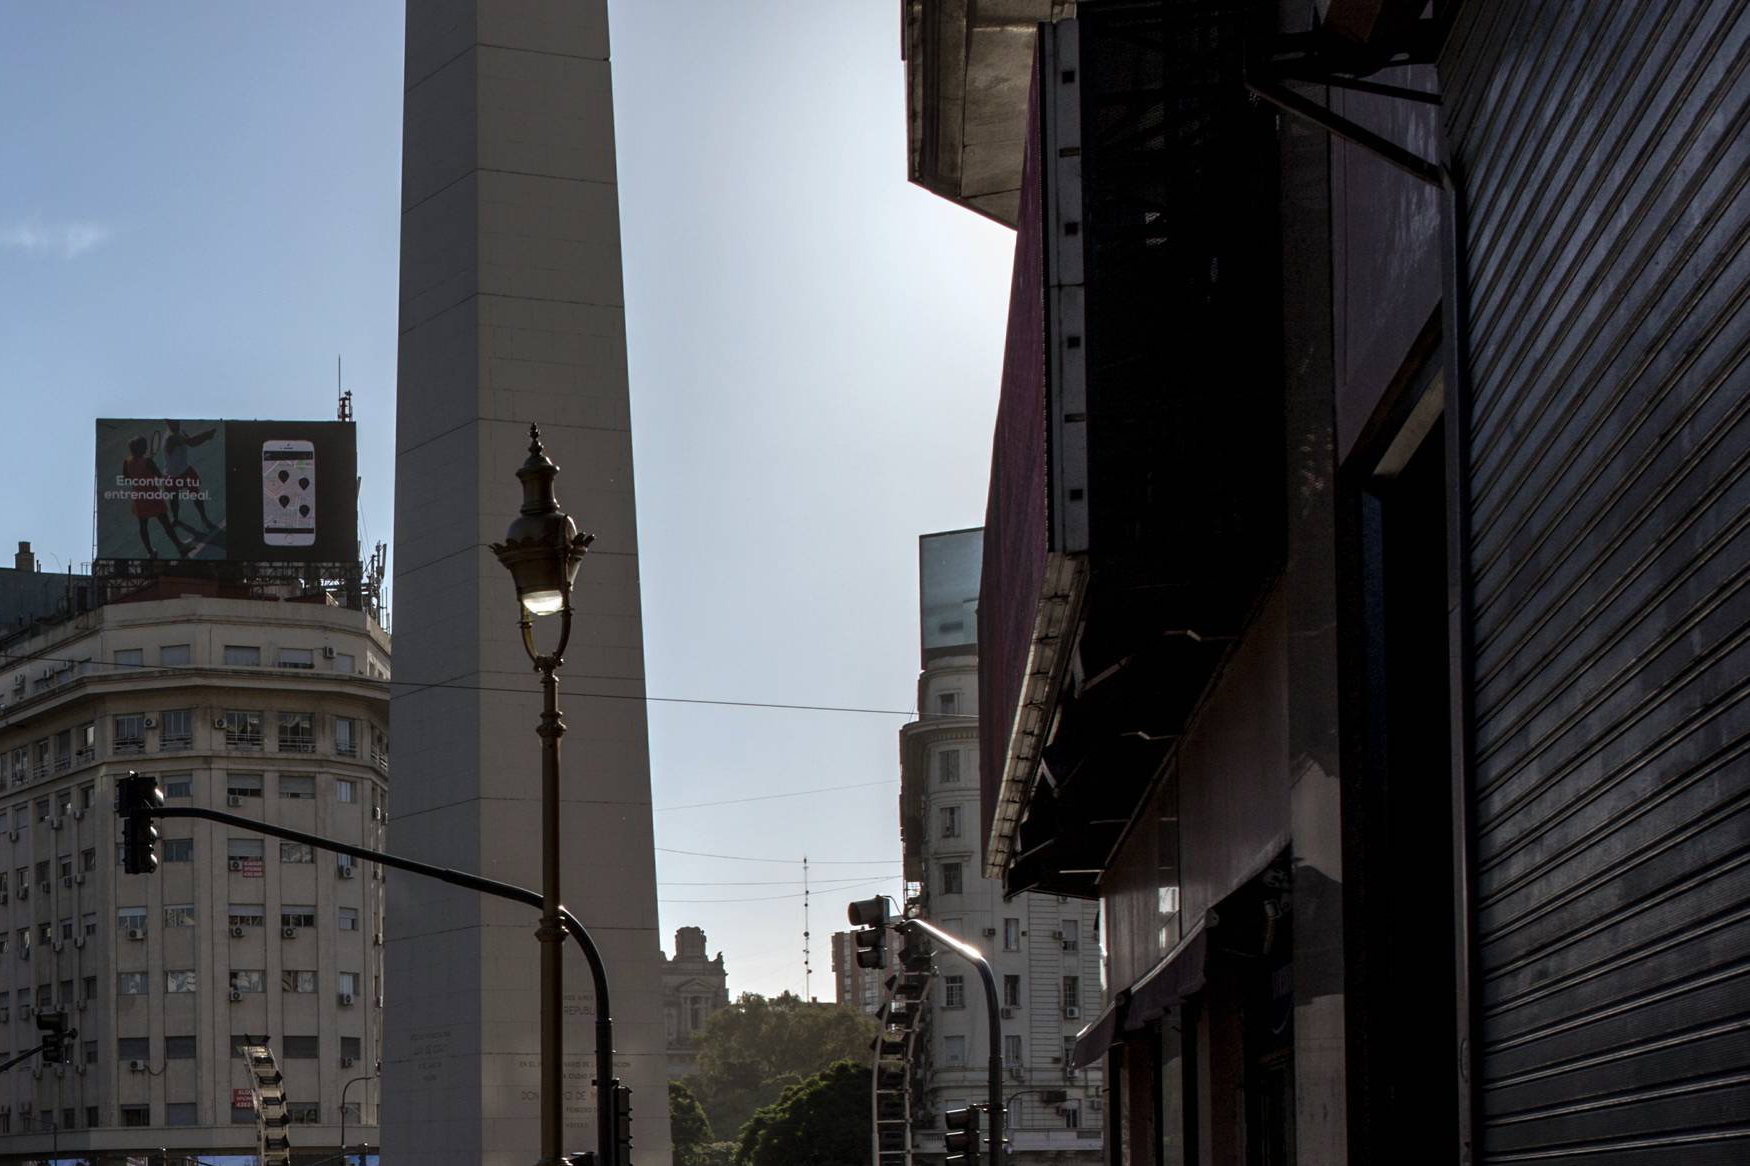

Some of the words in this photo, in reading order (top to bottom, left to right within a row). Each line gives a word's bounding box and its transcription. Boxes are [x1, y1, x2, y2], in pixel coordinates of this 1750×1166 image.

[116, 475, 173, 487] Encontrá
[175, 478, 186, 487] a
[187, 477, 200, 487] tu
[104, 490, 176, 500] entrenador
[178, 489, 212, 501] ideal.
